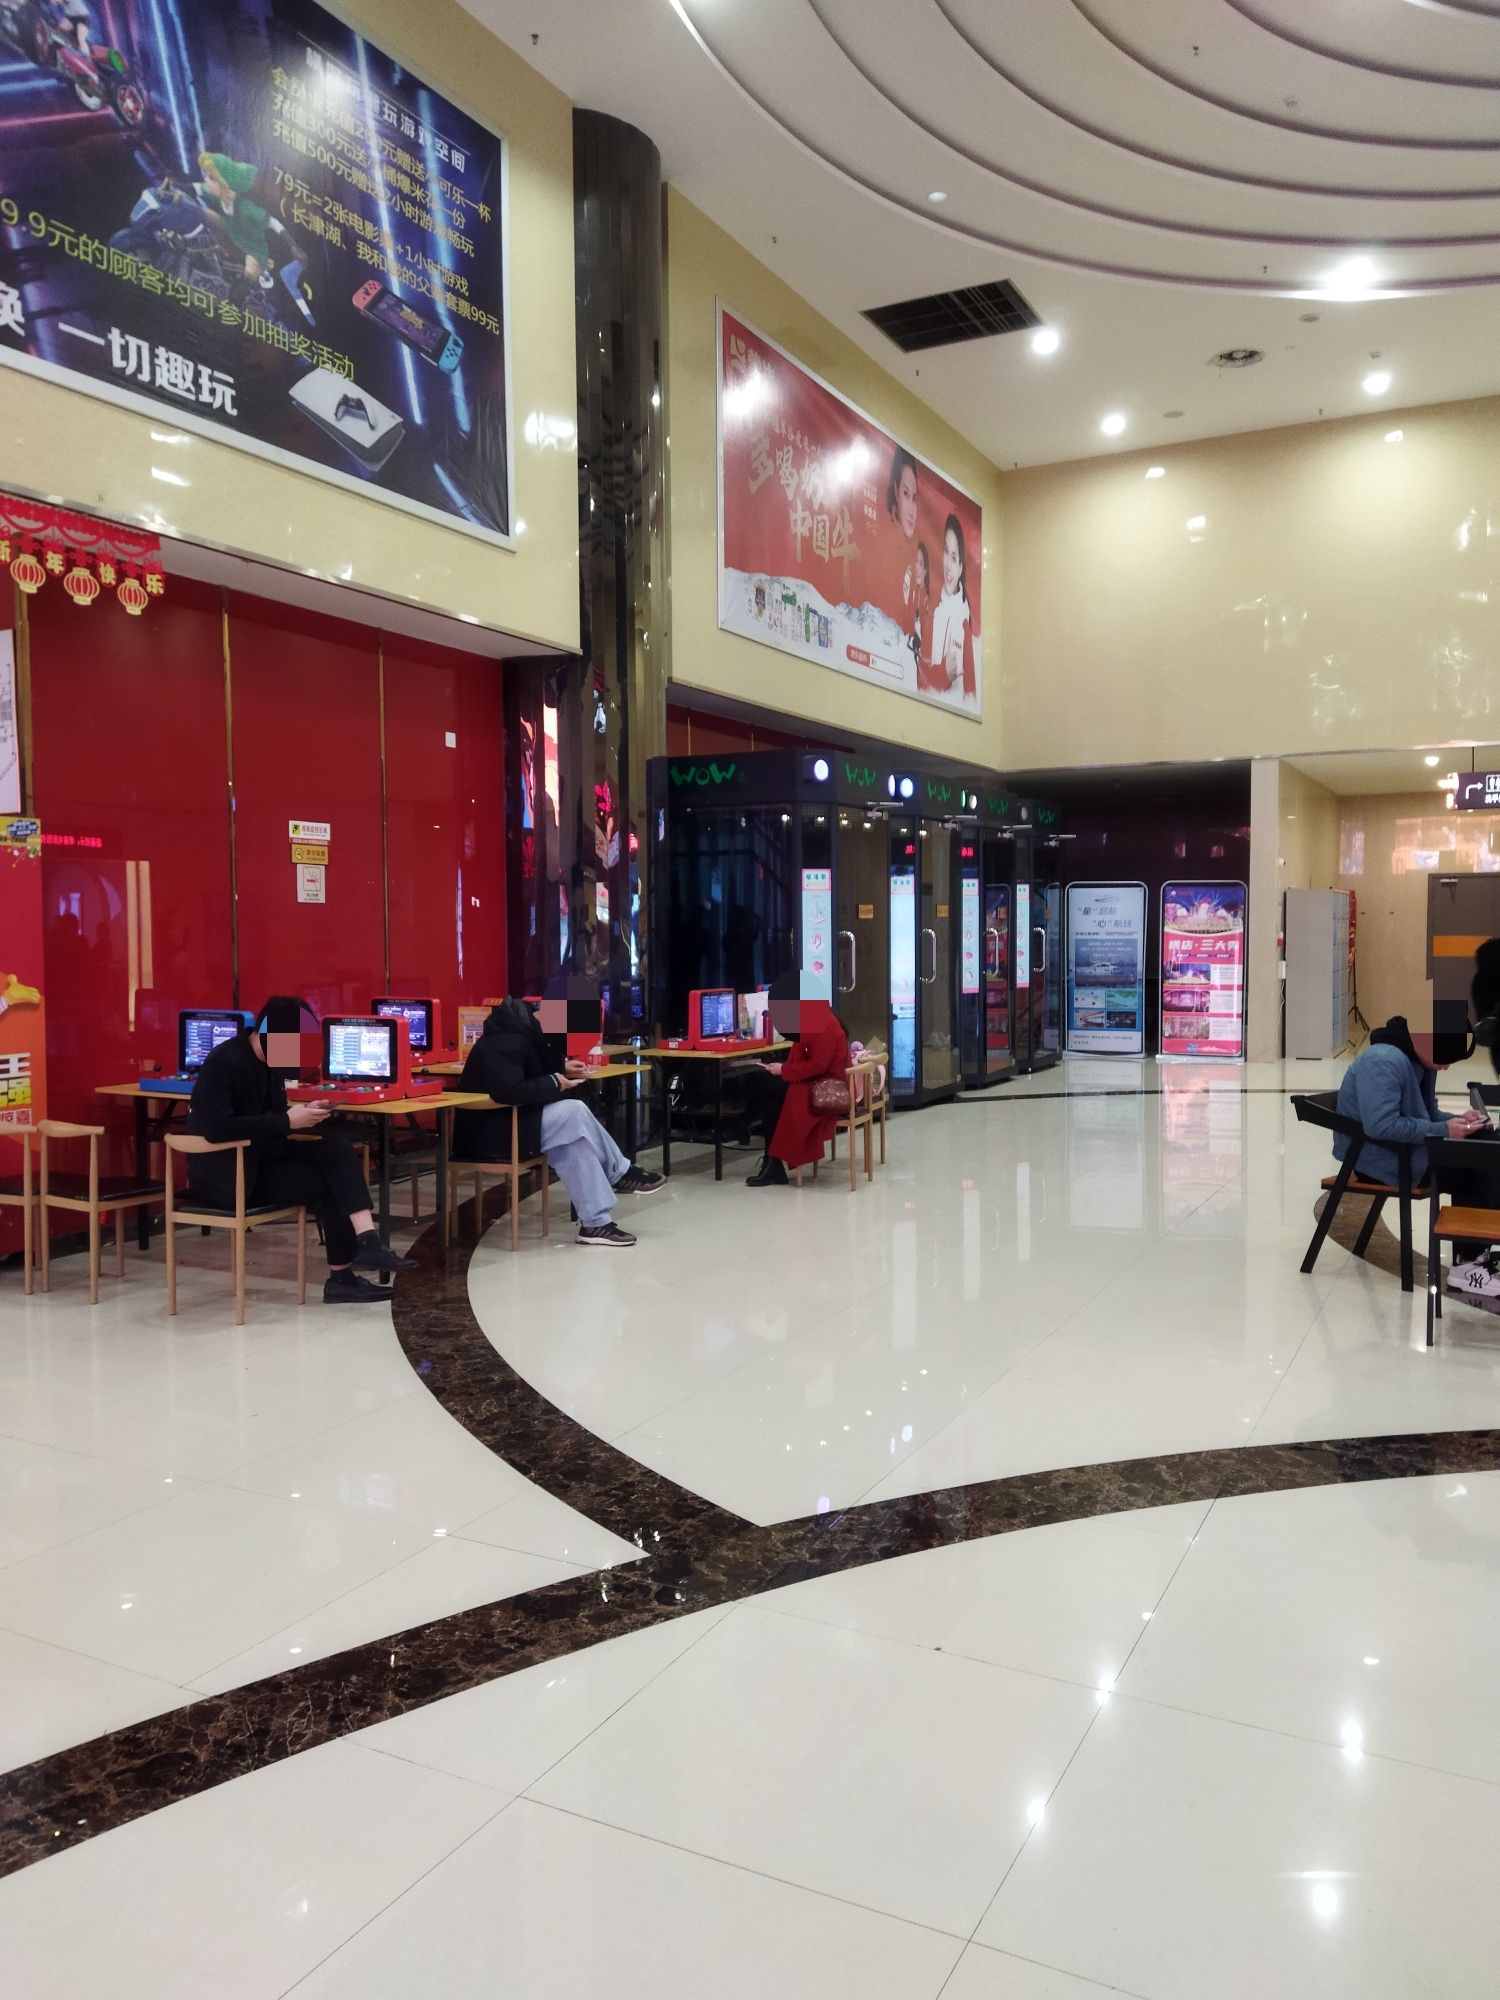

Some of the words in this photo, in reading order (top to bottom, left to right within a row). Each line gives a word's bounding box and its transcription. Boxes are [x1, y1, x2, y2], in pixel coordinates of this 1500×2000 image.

[58, 321, 238, 417] 一切趣玩
[1484, 793, 1500, 804] 洗手
